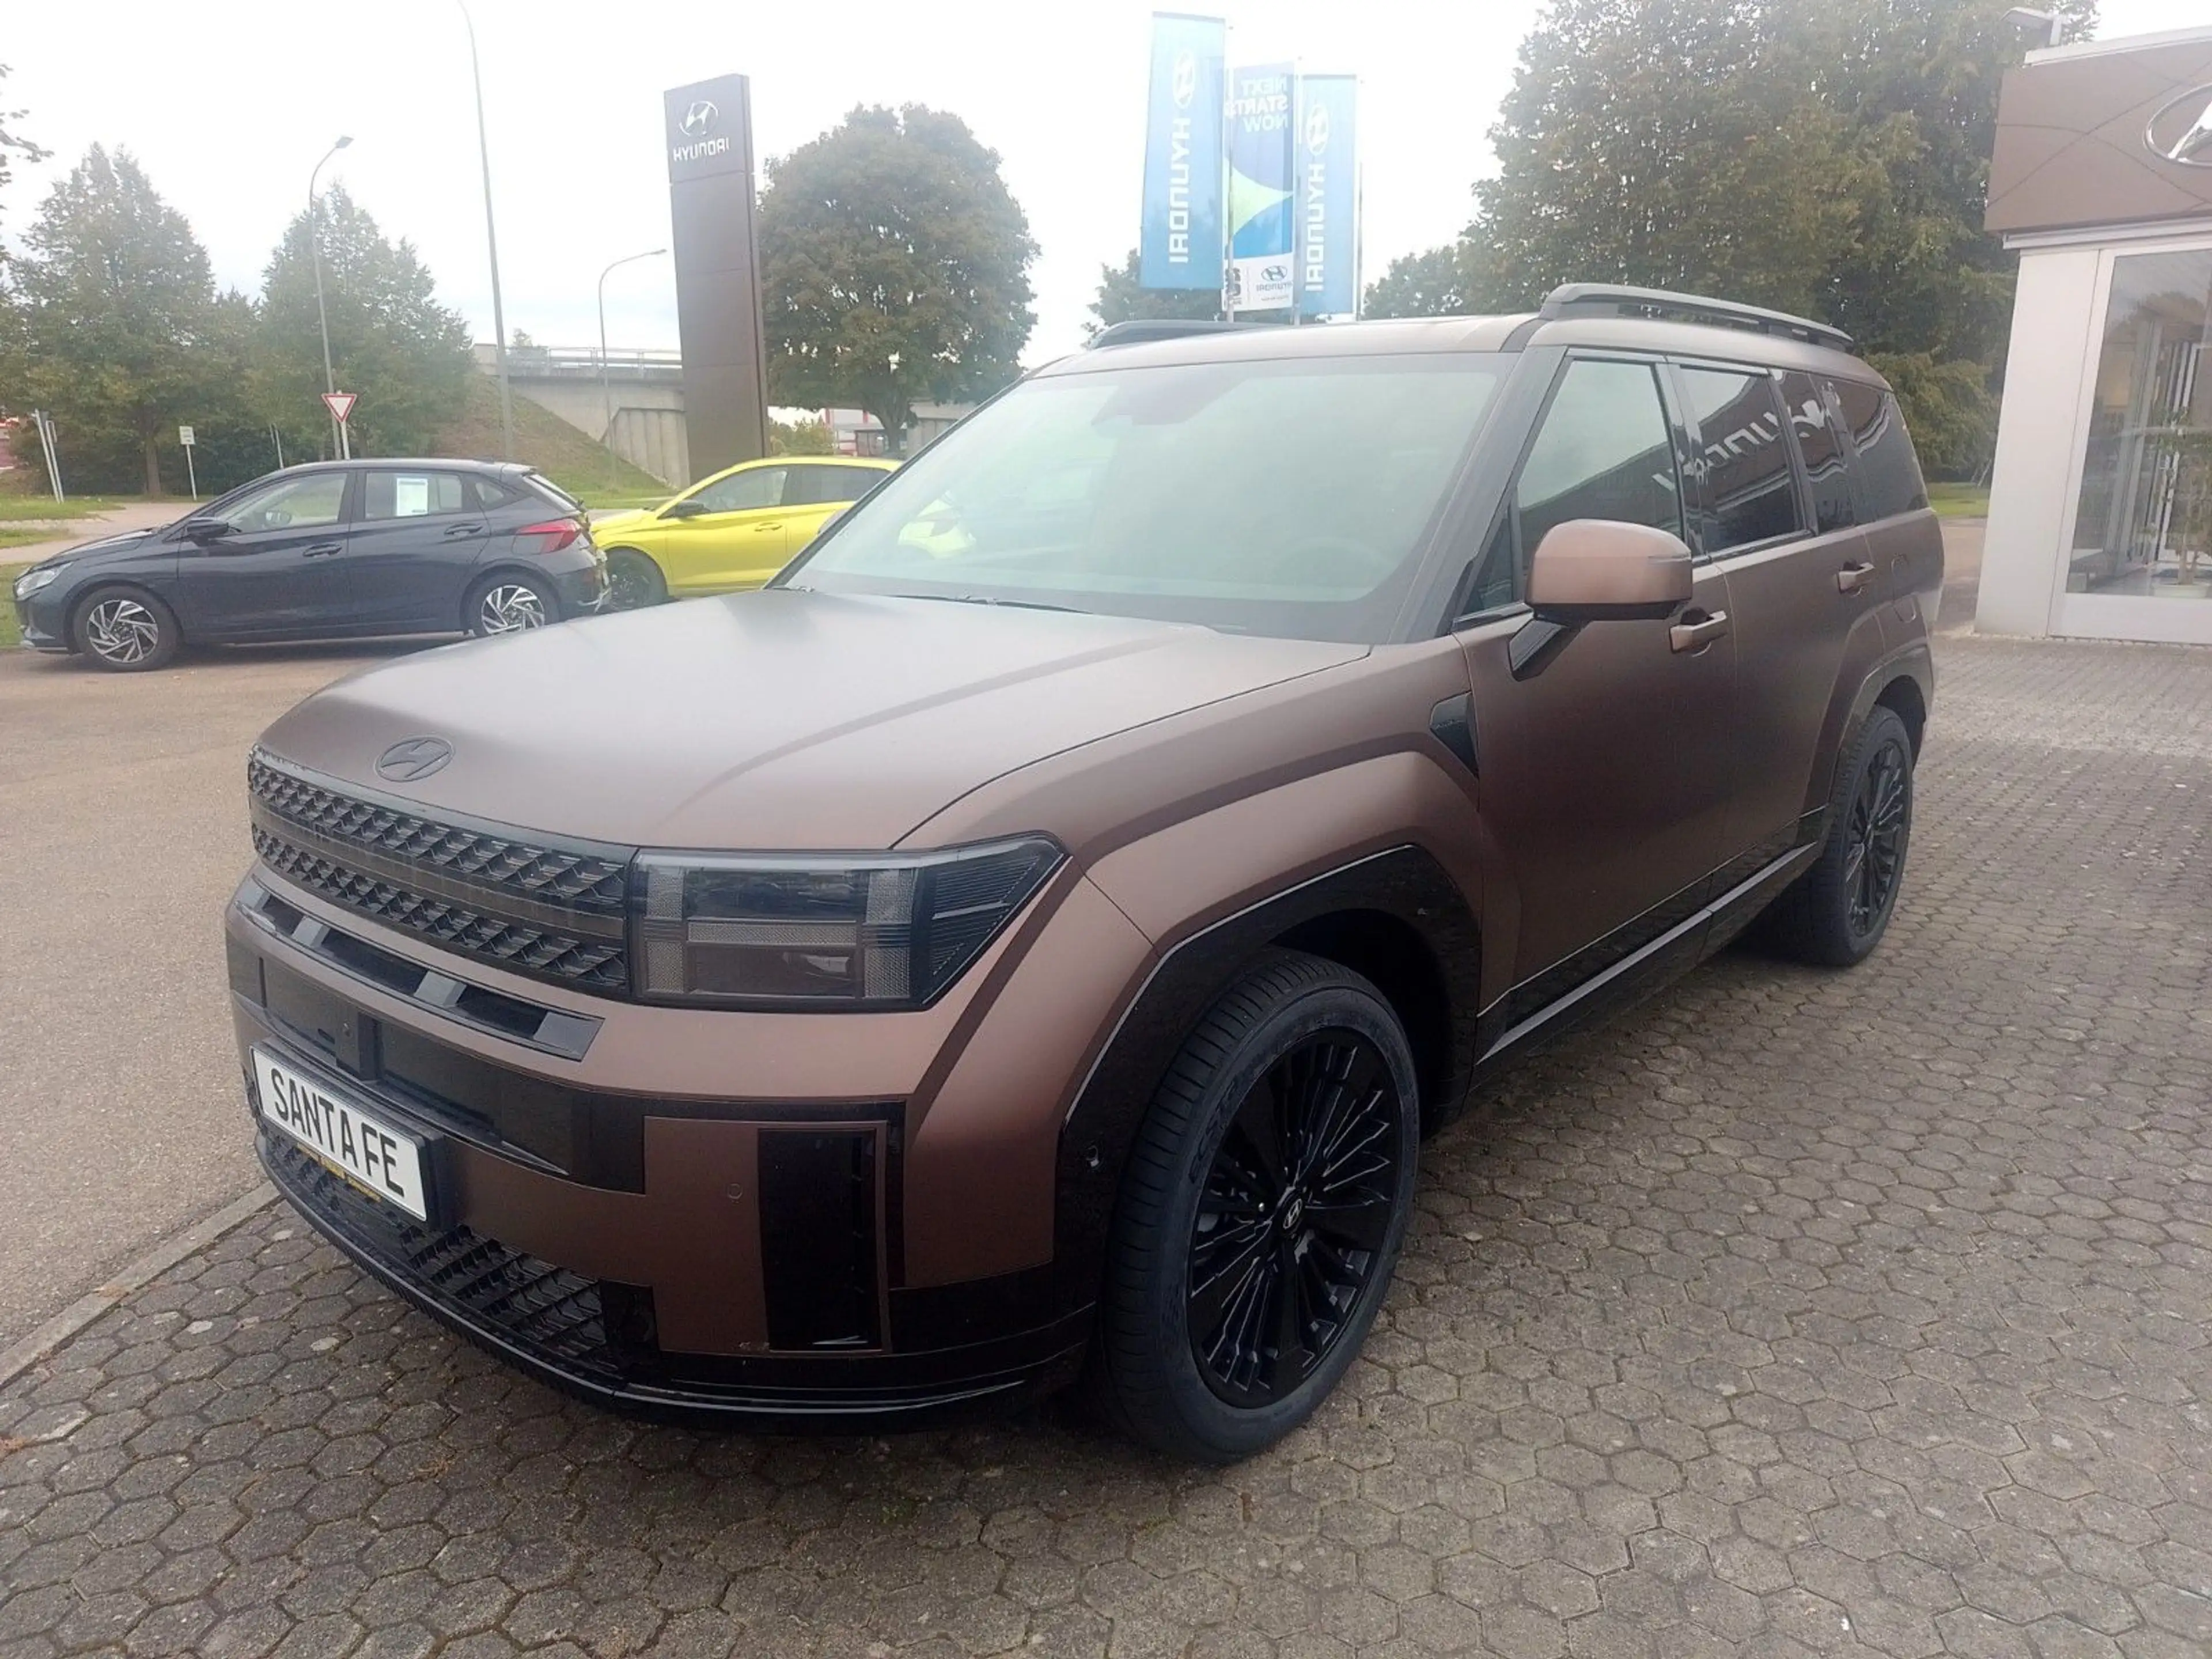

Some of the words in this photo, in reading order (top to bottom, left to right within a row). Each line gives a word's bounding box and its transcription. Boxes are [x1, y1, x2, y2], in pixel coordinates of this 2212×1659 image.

[672, 137, 729, 162] HYUNDAI
[271, 1067, 358, 1169] SANTA
[361, 1122, 404, 1197] FE
